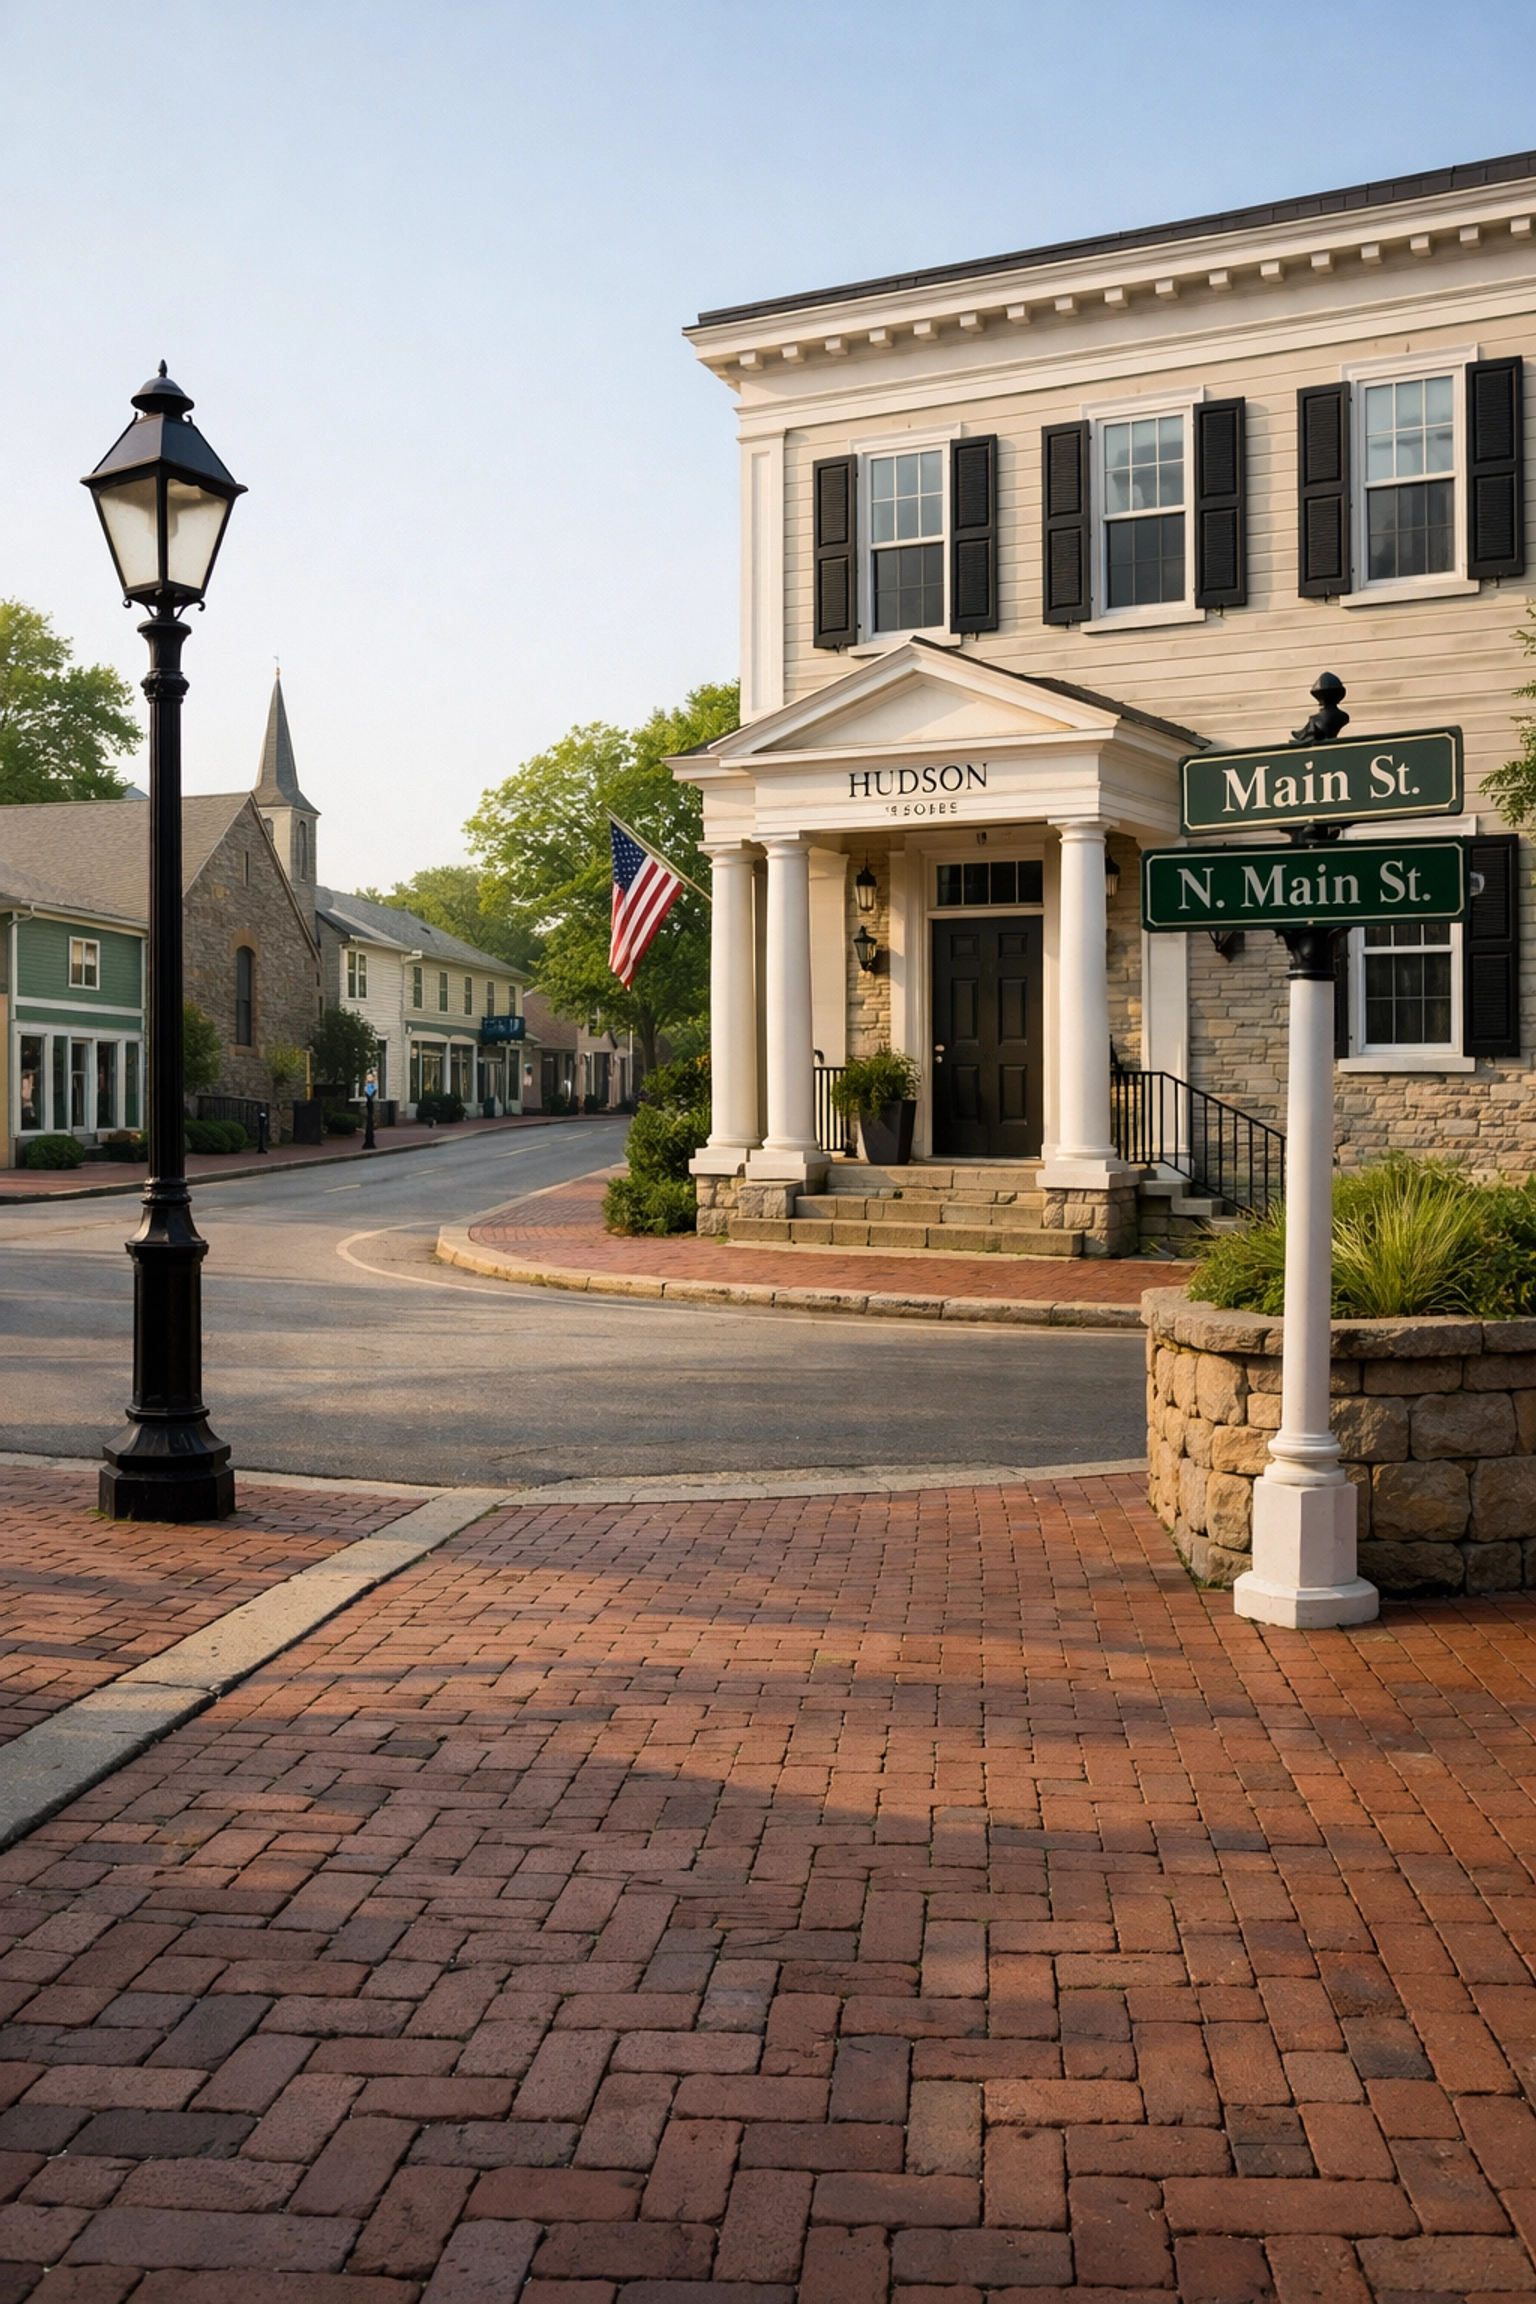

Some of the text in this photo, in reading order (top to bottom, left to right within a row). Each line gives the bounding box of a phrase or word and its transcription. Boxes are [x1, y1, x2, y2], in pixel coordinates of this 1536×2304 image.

[849, 763, 987, 798] HUDSON
[1221, 754, 1421, 813] Main St.
[1177, 860, 1432, 910] N. Main St.
